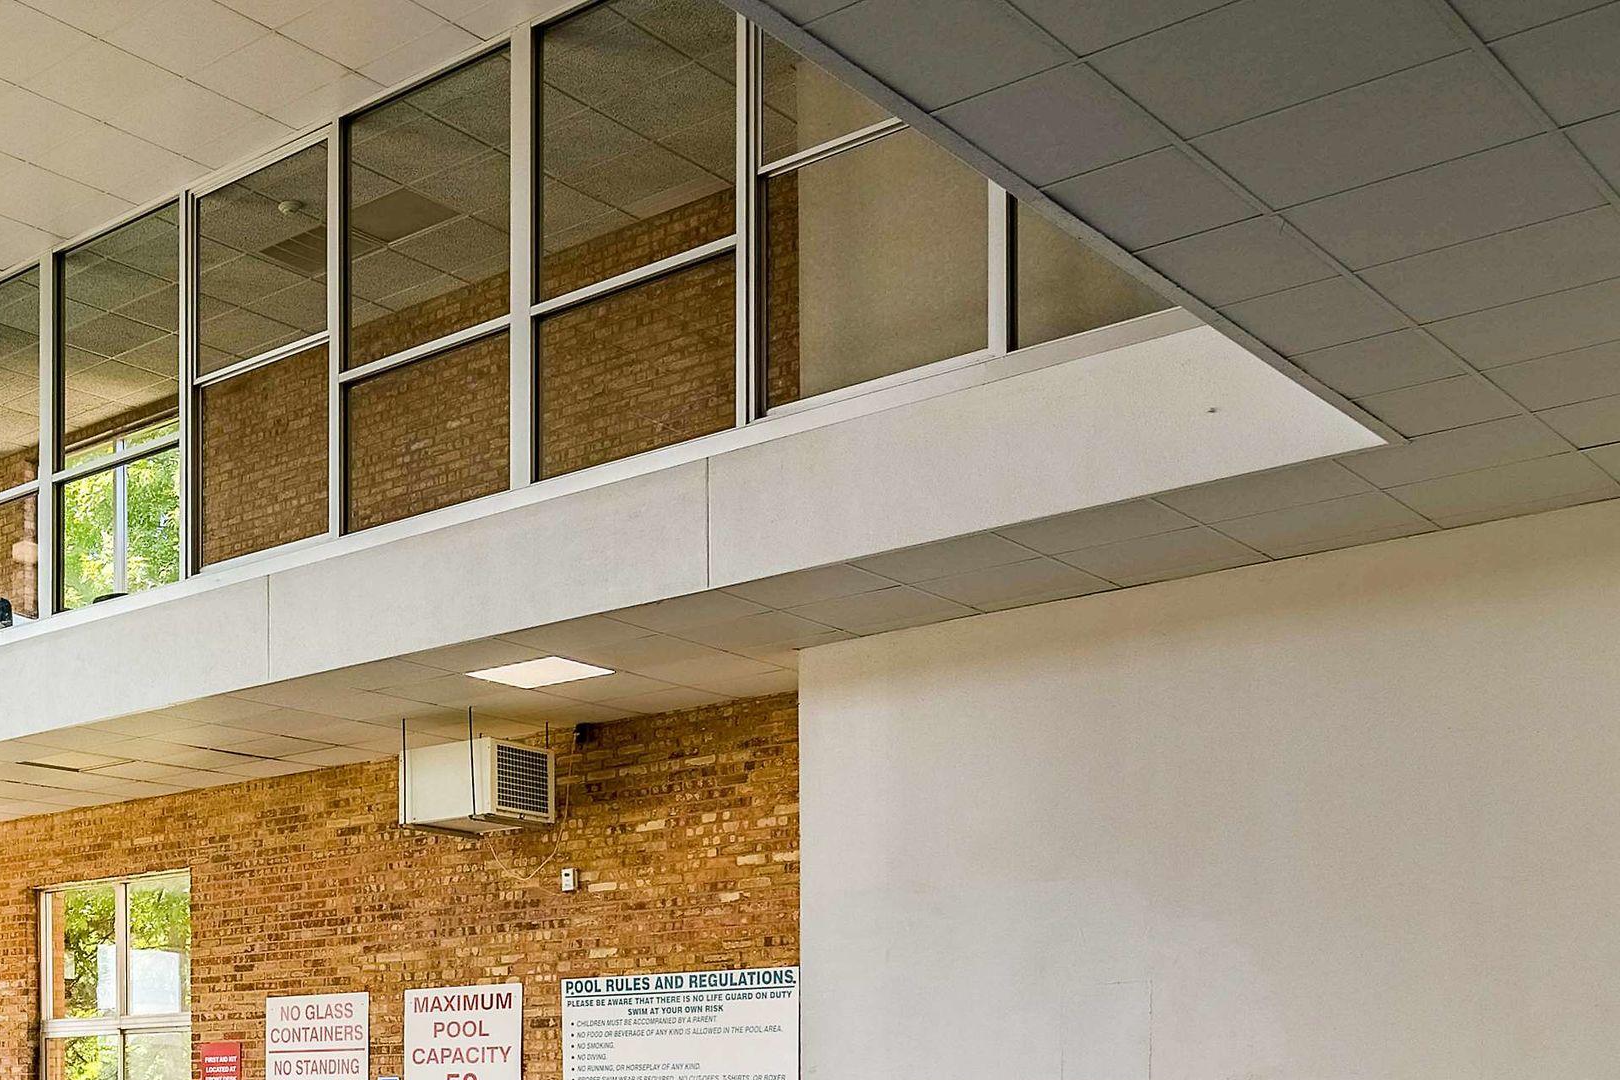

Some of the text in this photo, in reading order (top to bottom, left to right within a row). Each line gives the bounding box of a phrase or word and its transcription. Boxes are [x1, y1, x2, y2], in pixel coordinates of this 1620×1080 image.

[566, 980, 602, 994] POOL
[606, 977, 650, 992] RULES
[655, 975, 684, 990] AND
[414, 992, 512, 1013] MAXIMUM
[567, 999, 594, 1007] PLEASE
[608, 998, 632, 1006] AWARE
[636, 997, 654, 1005] THAT
[770, 991, 792, 999] DUTY
[280, 1002, 353, 1021] NO GLASS
[433, 1020, 489, 1038] POOL
[633, 1017, 676, 1025] ACCOMPANIED
[270, 1024, 364, 1043] CONTAINERS
[692, 1026, 722, 1035] ALLOWED
[412, 1046, 512, 1064] CAPACITY
[274, 1058, 359, 1076] NO STANDING
